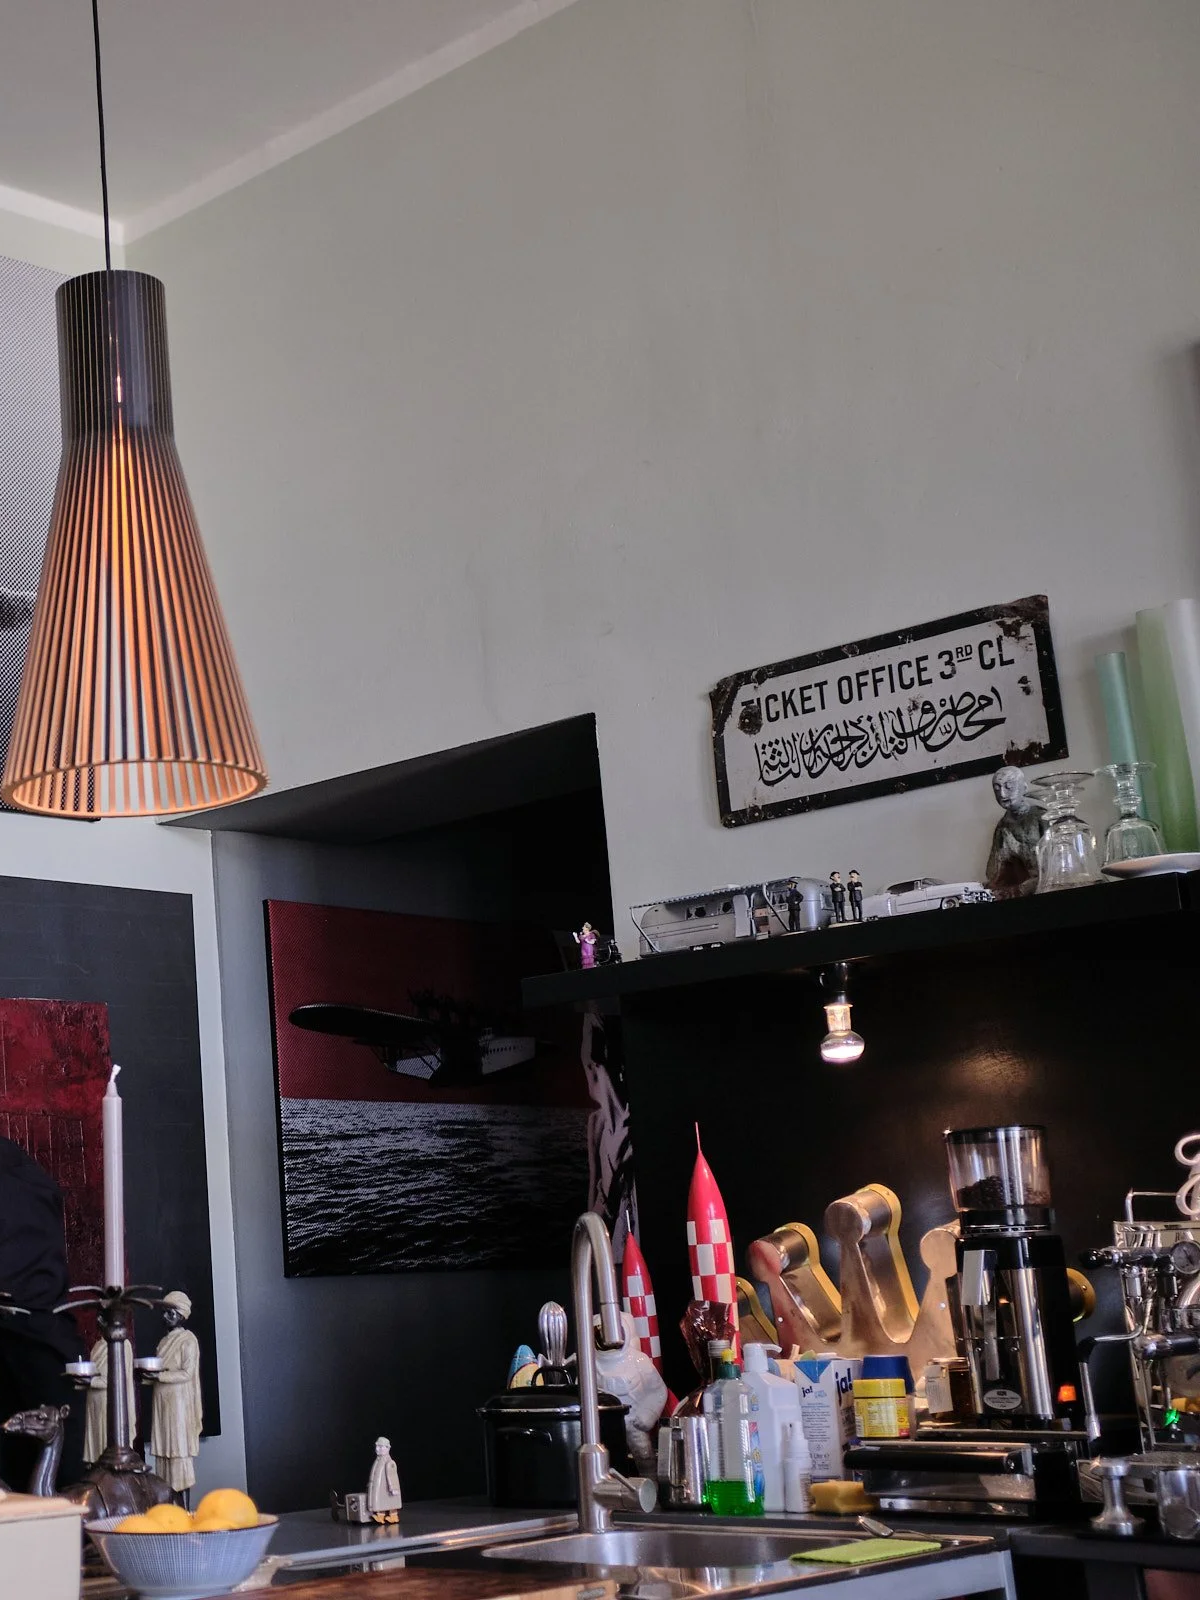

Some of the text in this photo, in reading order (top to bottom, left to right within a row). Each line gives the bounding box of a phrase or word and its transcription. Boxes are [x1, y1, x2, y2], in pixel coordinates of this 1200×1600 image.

[837, 655, 933, 704] OFFICE
[978, 635, 1015, 670] CL
[801, 1386, 813, 1398] ja!
[835, 1368, 853, 1407] ja!
